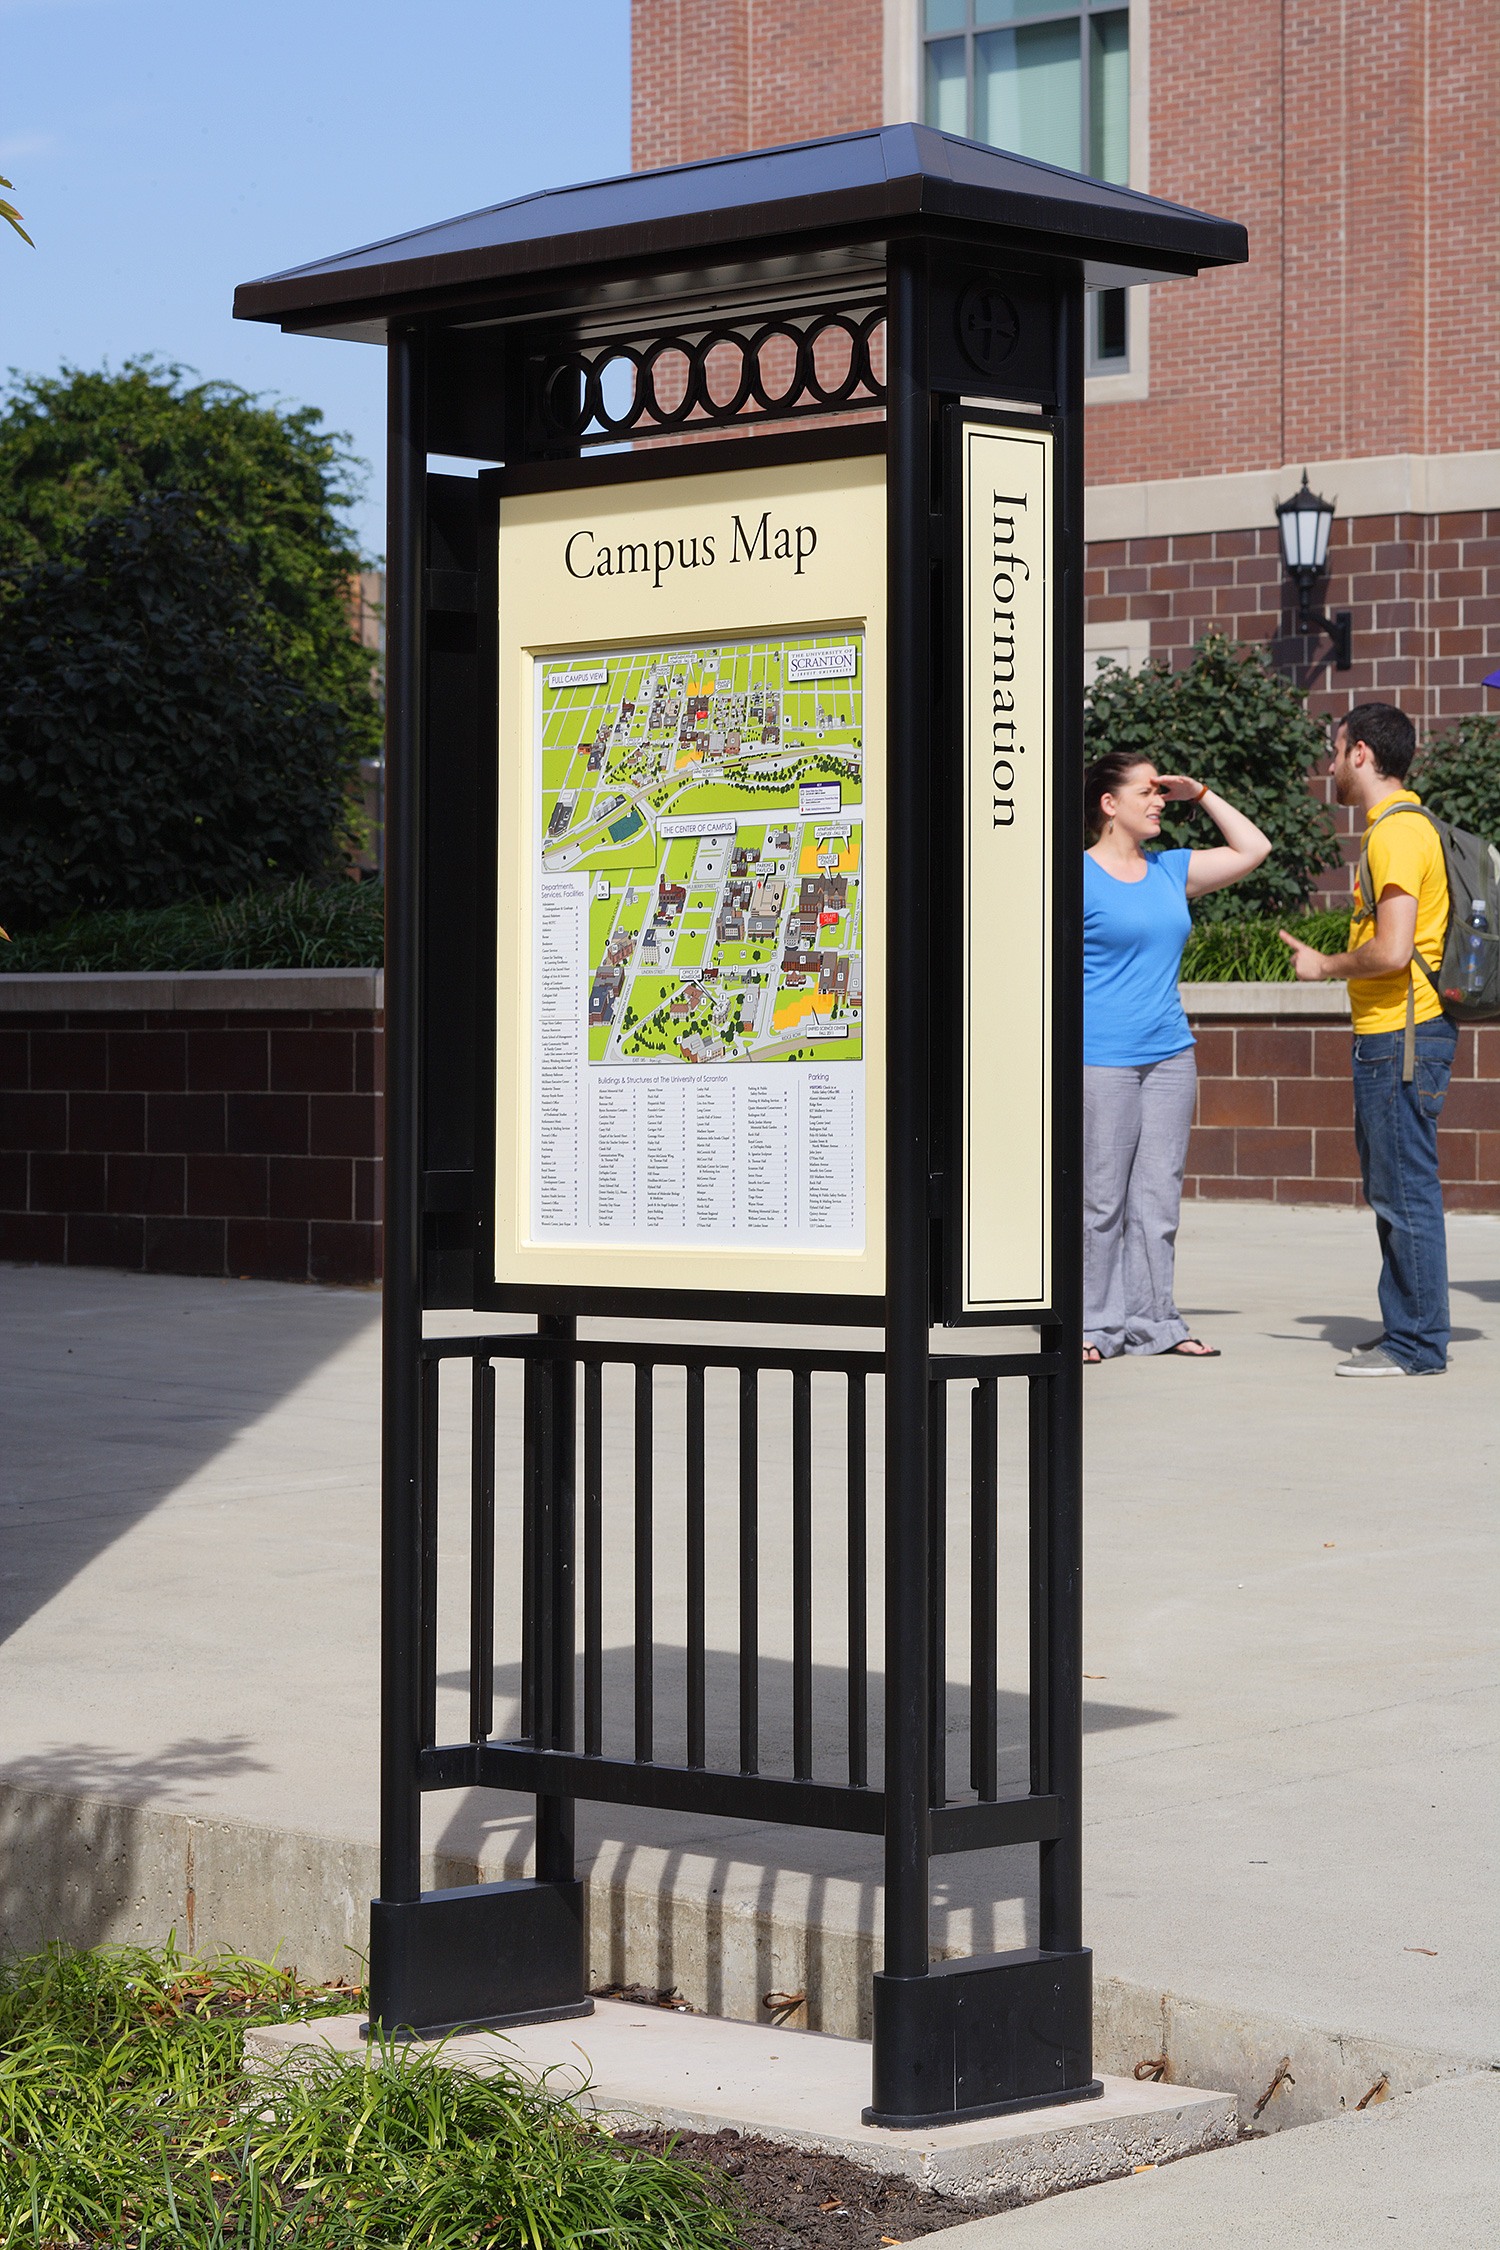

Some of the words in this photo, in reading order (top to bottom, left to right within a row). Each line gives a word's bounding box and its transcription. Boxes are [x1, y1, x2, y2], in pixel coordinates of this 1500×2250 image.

[564, 530, 716, 588] Campus
[729, 511, 818, 575] Map
[806, 649, 842, 657] UNIVERSITY
[790, 654, 853, 672] SCRANTON
[992, 489, 1030, 830] Information
[565, 673, 589, 683] CAMPUS
[590, 672, 604, 680] VIEW
[663, 826, 674, 834] THE
[674, 824, 697, 833] CENTER
[697, 823, 706, 832] OF
[706, 822, 733, 832] CAMPUS
[541, 883, 574, 892] Departments,
[597, 1076, 620, 1085] Buildings
[626, 1076, 652, 1084] Structures
[671, 1075, 695, 1084] University
[808, 1073, 830, 1082] Parking
